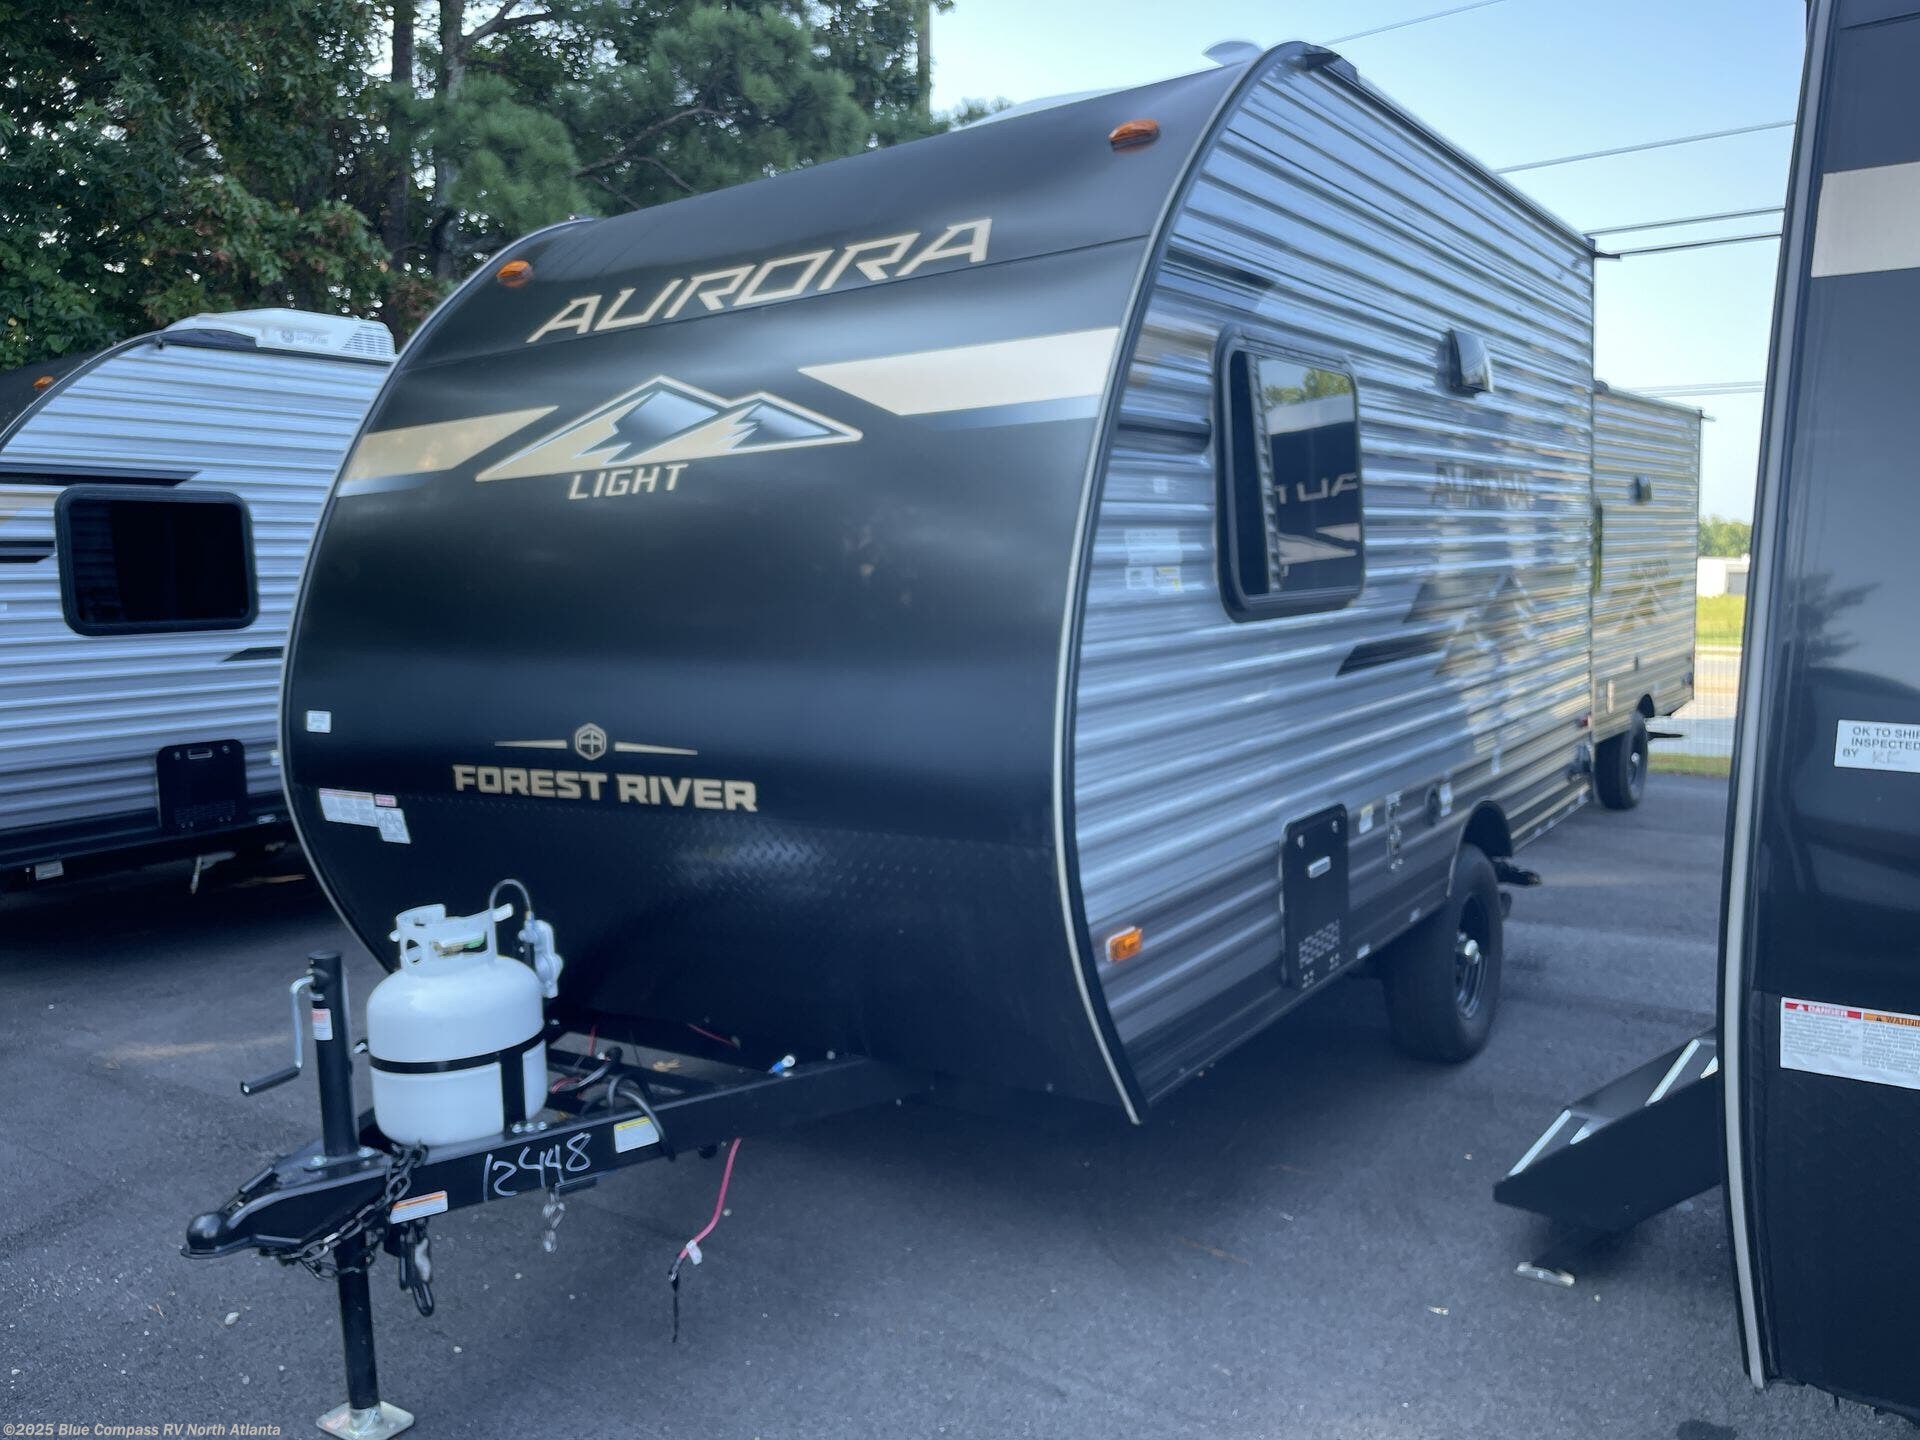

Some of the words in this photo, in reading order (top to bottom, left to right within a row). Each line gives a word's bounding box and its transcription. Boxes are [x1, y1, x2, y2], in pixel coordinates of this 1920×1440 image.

[525, 217, 993, 343] AURORA
[568, 463, 690, 501] LIGHT
[1842, 748, 1859, 758] BY
[1852, 726, 1871, 736] OK
[1874, 727, 1891, 738] TO
[452, 764, 607, 800] FOREST
[616, 772, 758, 812] RIVER
[482, 1131, 592, 1202] 12448
